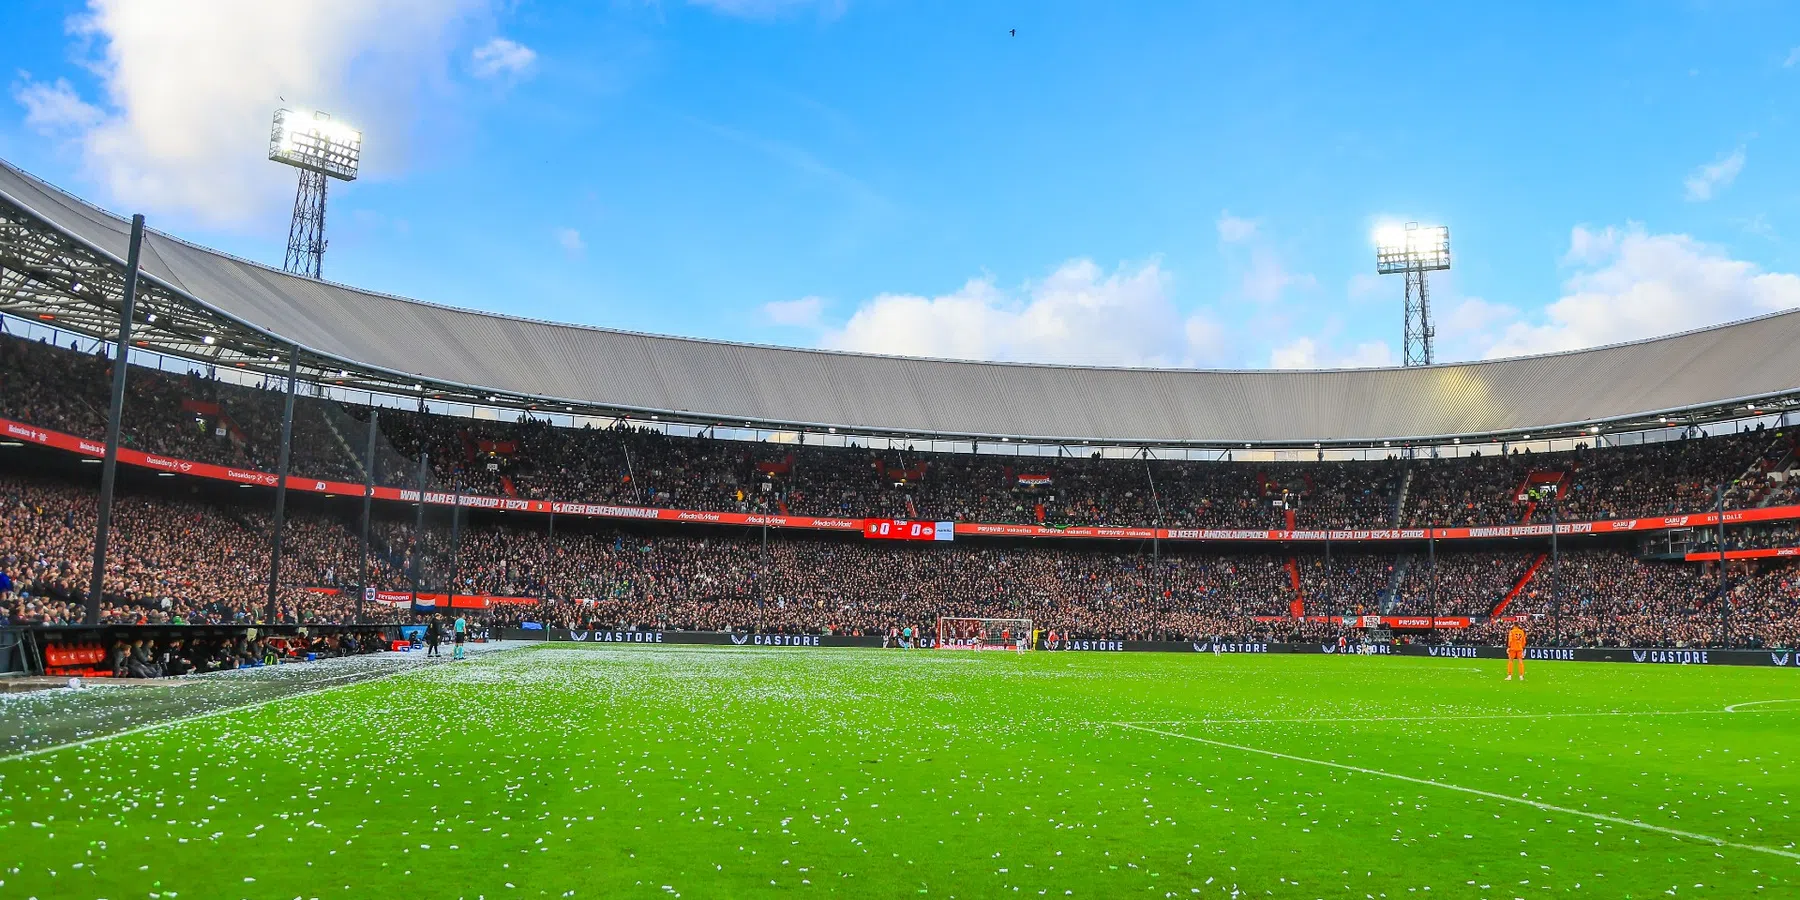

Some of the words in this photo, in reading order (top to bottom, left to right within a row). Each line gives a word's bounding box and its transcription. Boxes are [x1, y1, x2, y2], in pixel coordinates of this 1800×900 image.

[315, 482, 326, 490] AD
[561, 504, 585, 513] KEER
[585, 506, 659, 519] BEKERWINNAAR
[1707, 513, 1743, 522] RIVRDALE
[880, 523, 889, 535] 0
[911, 524, 921, 536] 0
[1177, 530, 1198, 538] KEER
[1199, 530, 1269, 539] LANDSKAMPIOEN
[1353, 531, 1370, 539] CUP
[1400, 530, 1424, 538] 2002
[1469, 527, 1511, 537] WINNAAR
[1571, 523, 1592, 533] 1970
[594, 631, 663, 643] CASTORE
[754, 635, 819, 646] CASTORE
[1065, 640, 1124, 651] CASTORE
[1440, 647, 1477, 658] CASTORE
[1530, 649, 1574, 660] CASTORE
[1651, 651, 1709, 664] CASTORE
